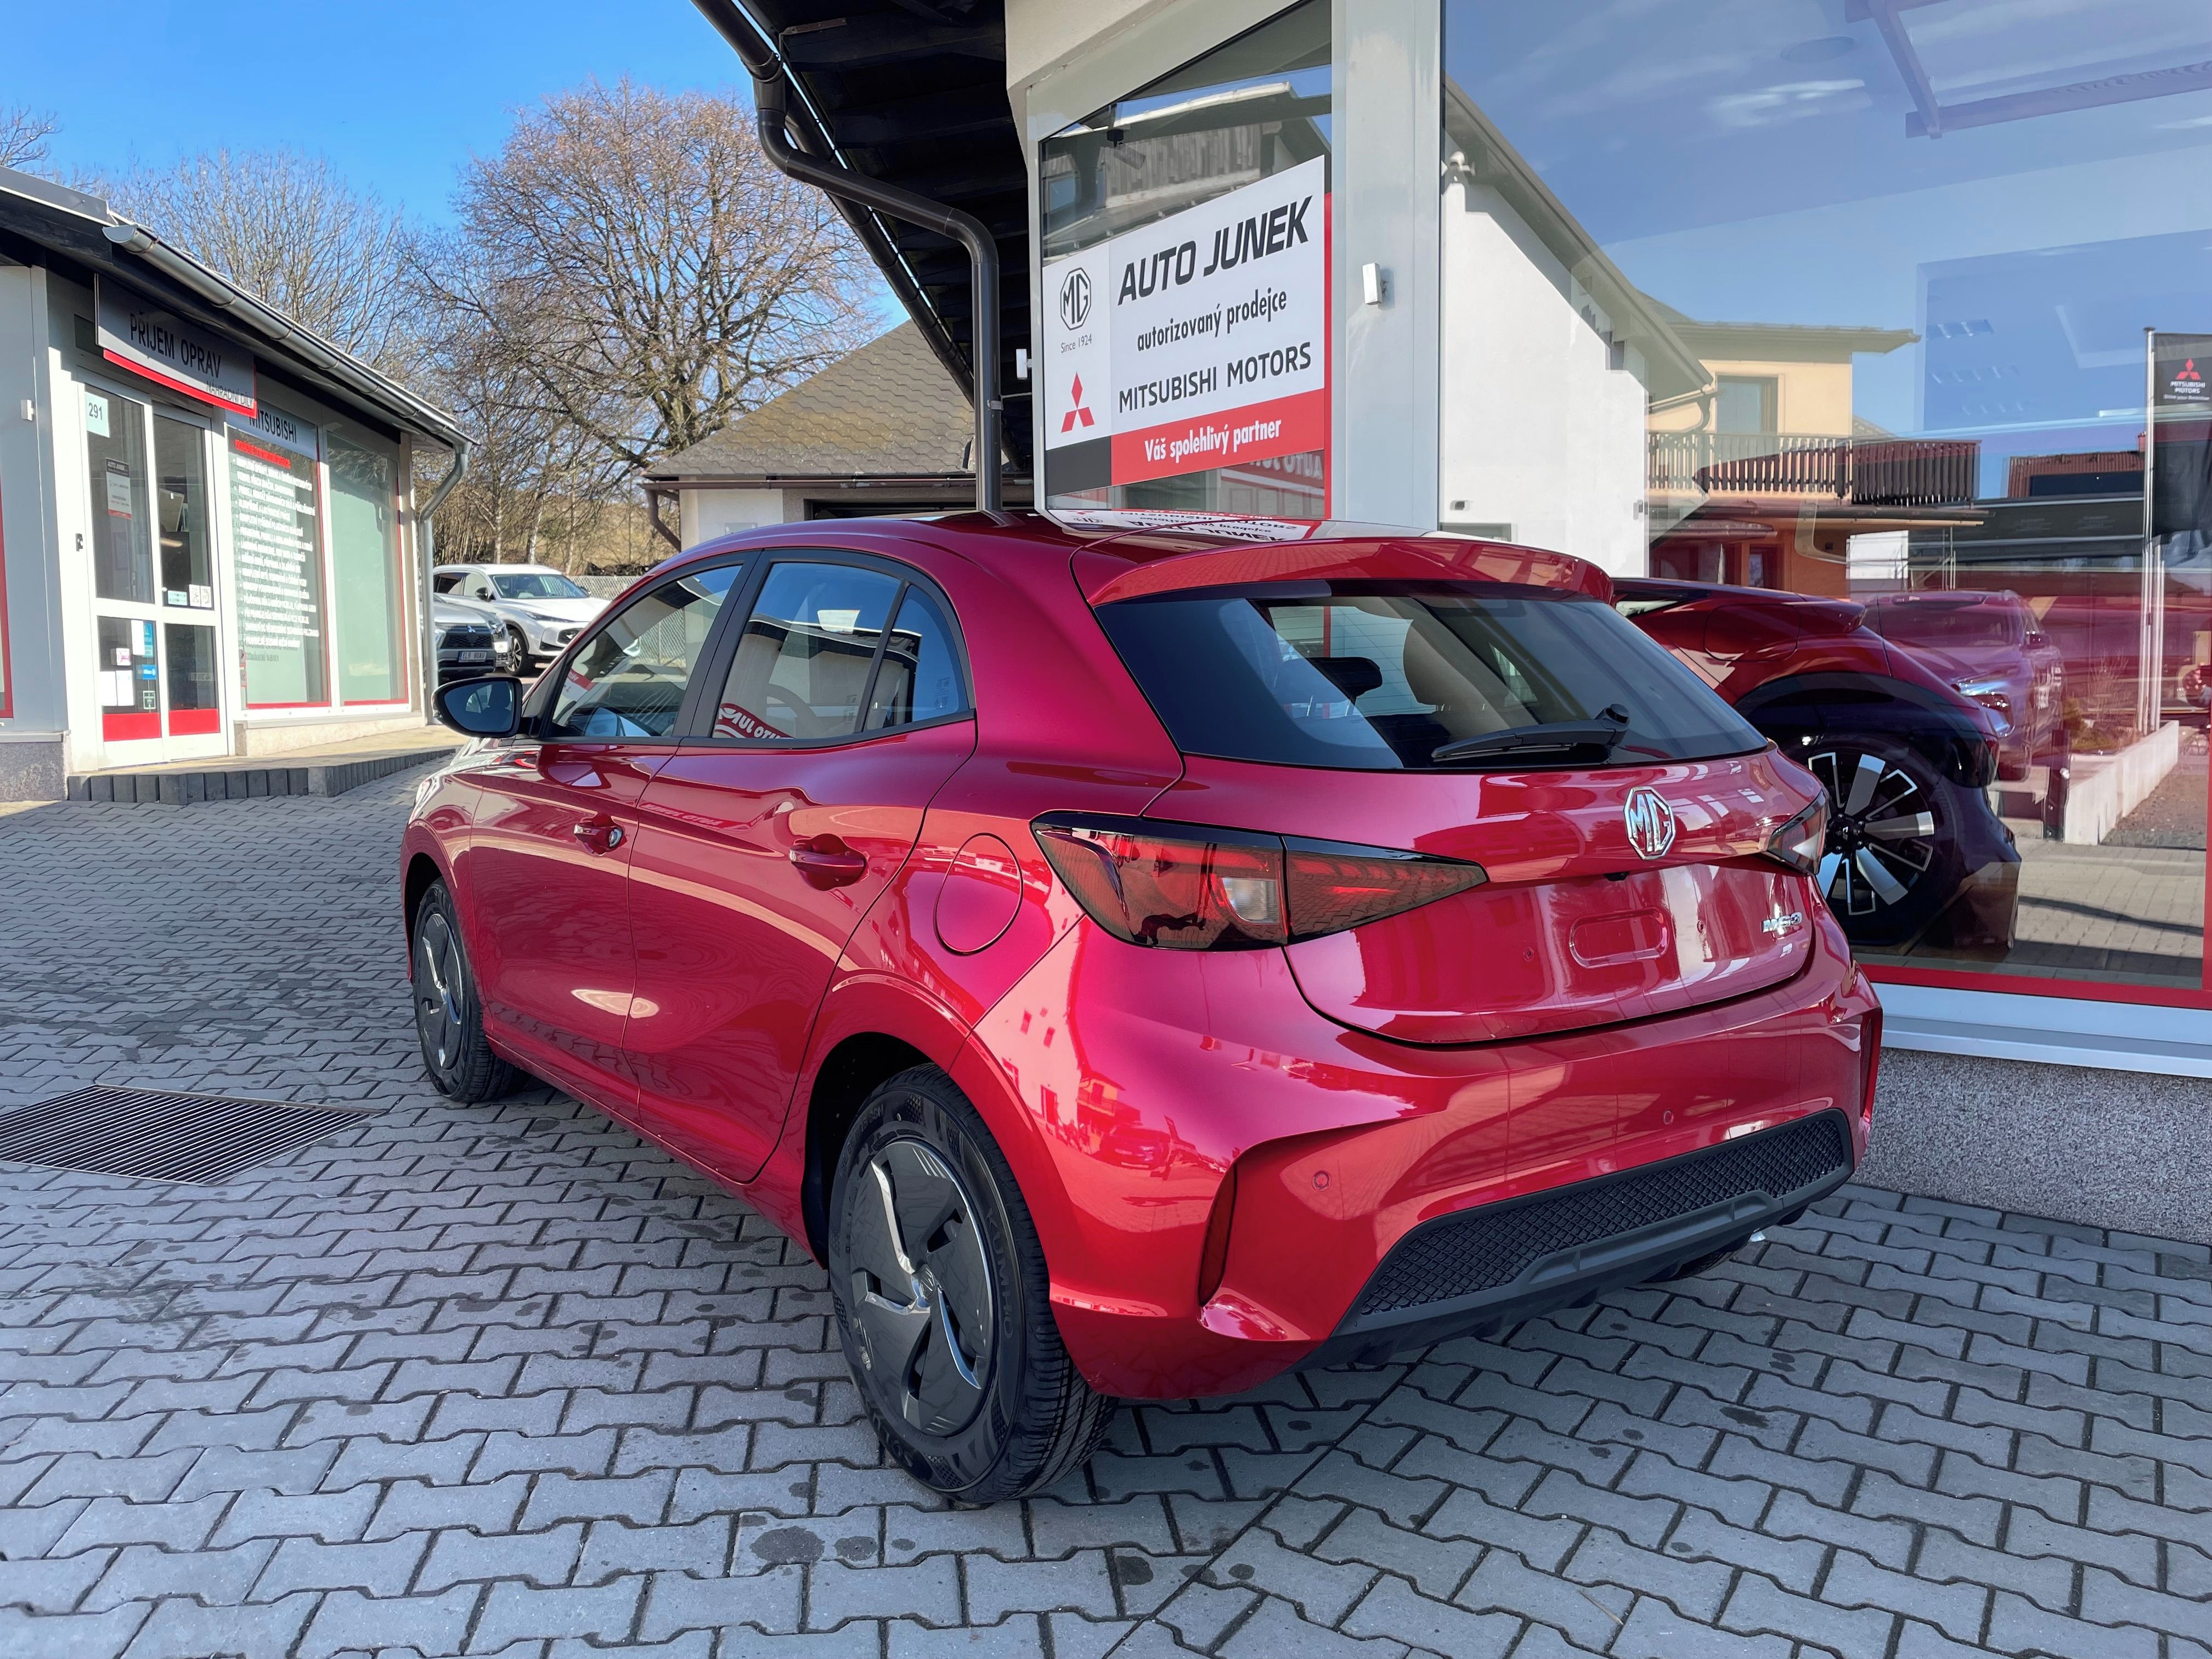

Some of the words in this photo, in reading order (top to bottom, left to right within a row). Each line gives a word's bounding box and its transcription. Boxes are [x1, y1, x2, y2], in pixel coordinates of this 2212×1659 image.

[1118, 240, 1197, 306] AUTO
[1203, 194, 1313, 278] JUNEK
[1063, 273, 1088, 325] MG
[1137, 303, 1222, 352] autorizovaný
[1227, 287, 1287, 334] prodejce
[181, 338, 221, 379] OPRAV
[1060, 341, 1076, 353] Since
[1078, 333, 1092, 348] 1924
[1119, 366, 1217, 413] MITSUBISHI
[1227, 341, 1311, 387] MOTORS
[2170, 380, 2206, 388] MITSUBISHI
[88, 402, 103, 420] 291
[1144, 437, 1166, 462] Váš
[1170, 424, 1230, 464] spolehlivý
[1233, 419, 1282, 453] partner
[1629, 793, 1672, 853] MG
[1762, 911, 1803, 933] MG3
[986, 1207, 1014, 1339] KUMHO
